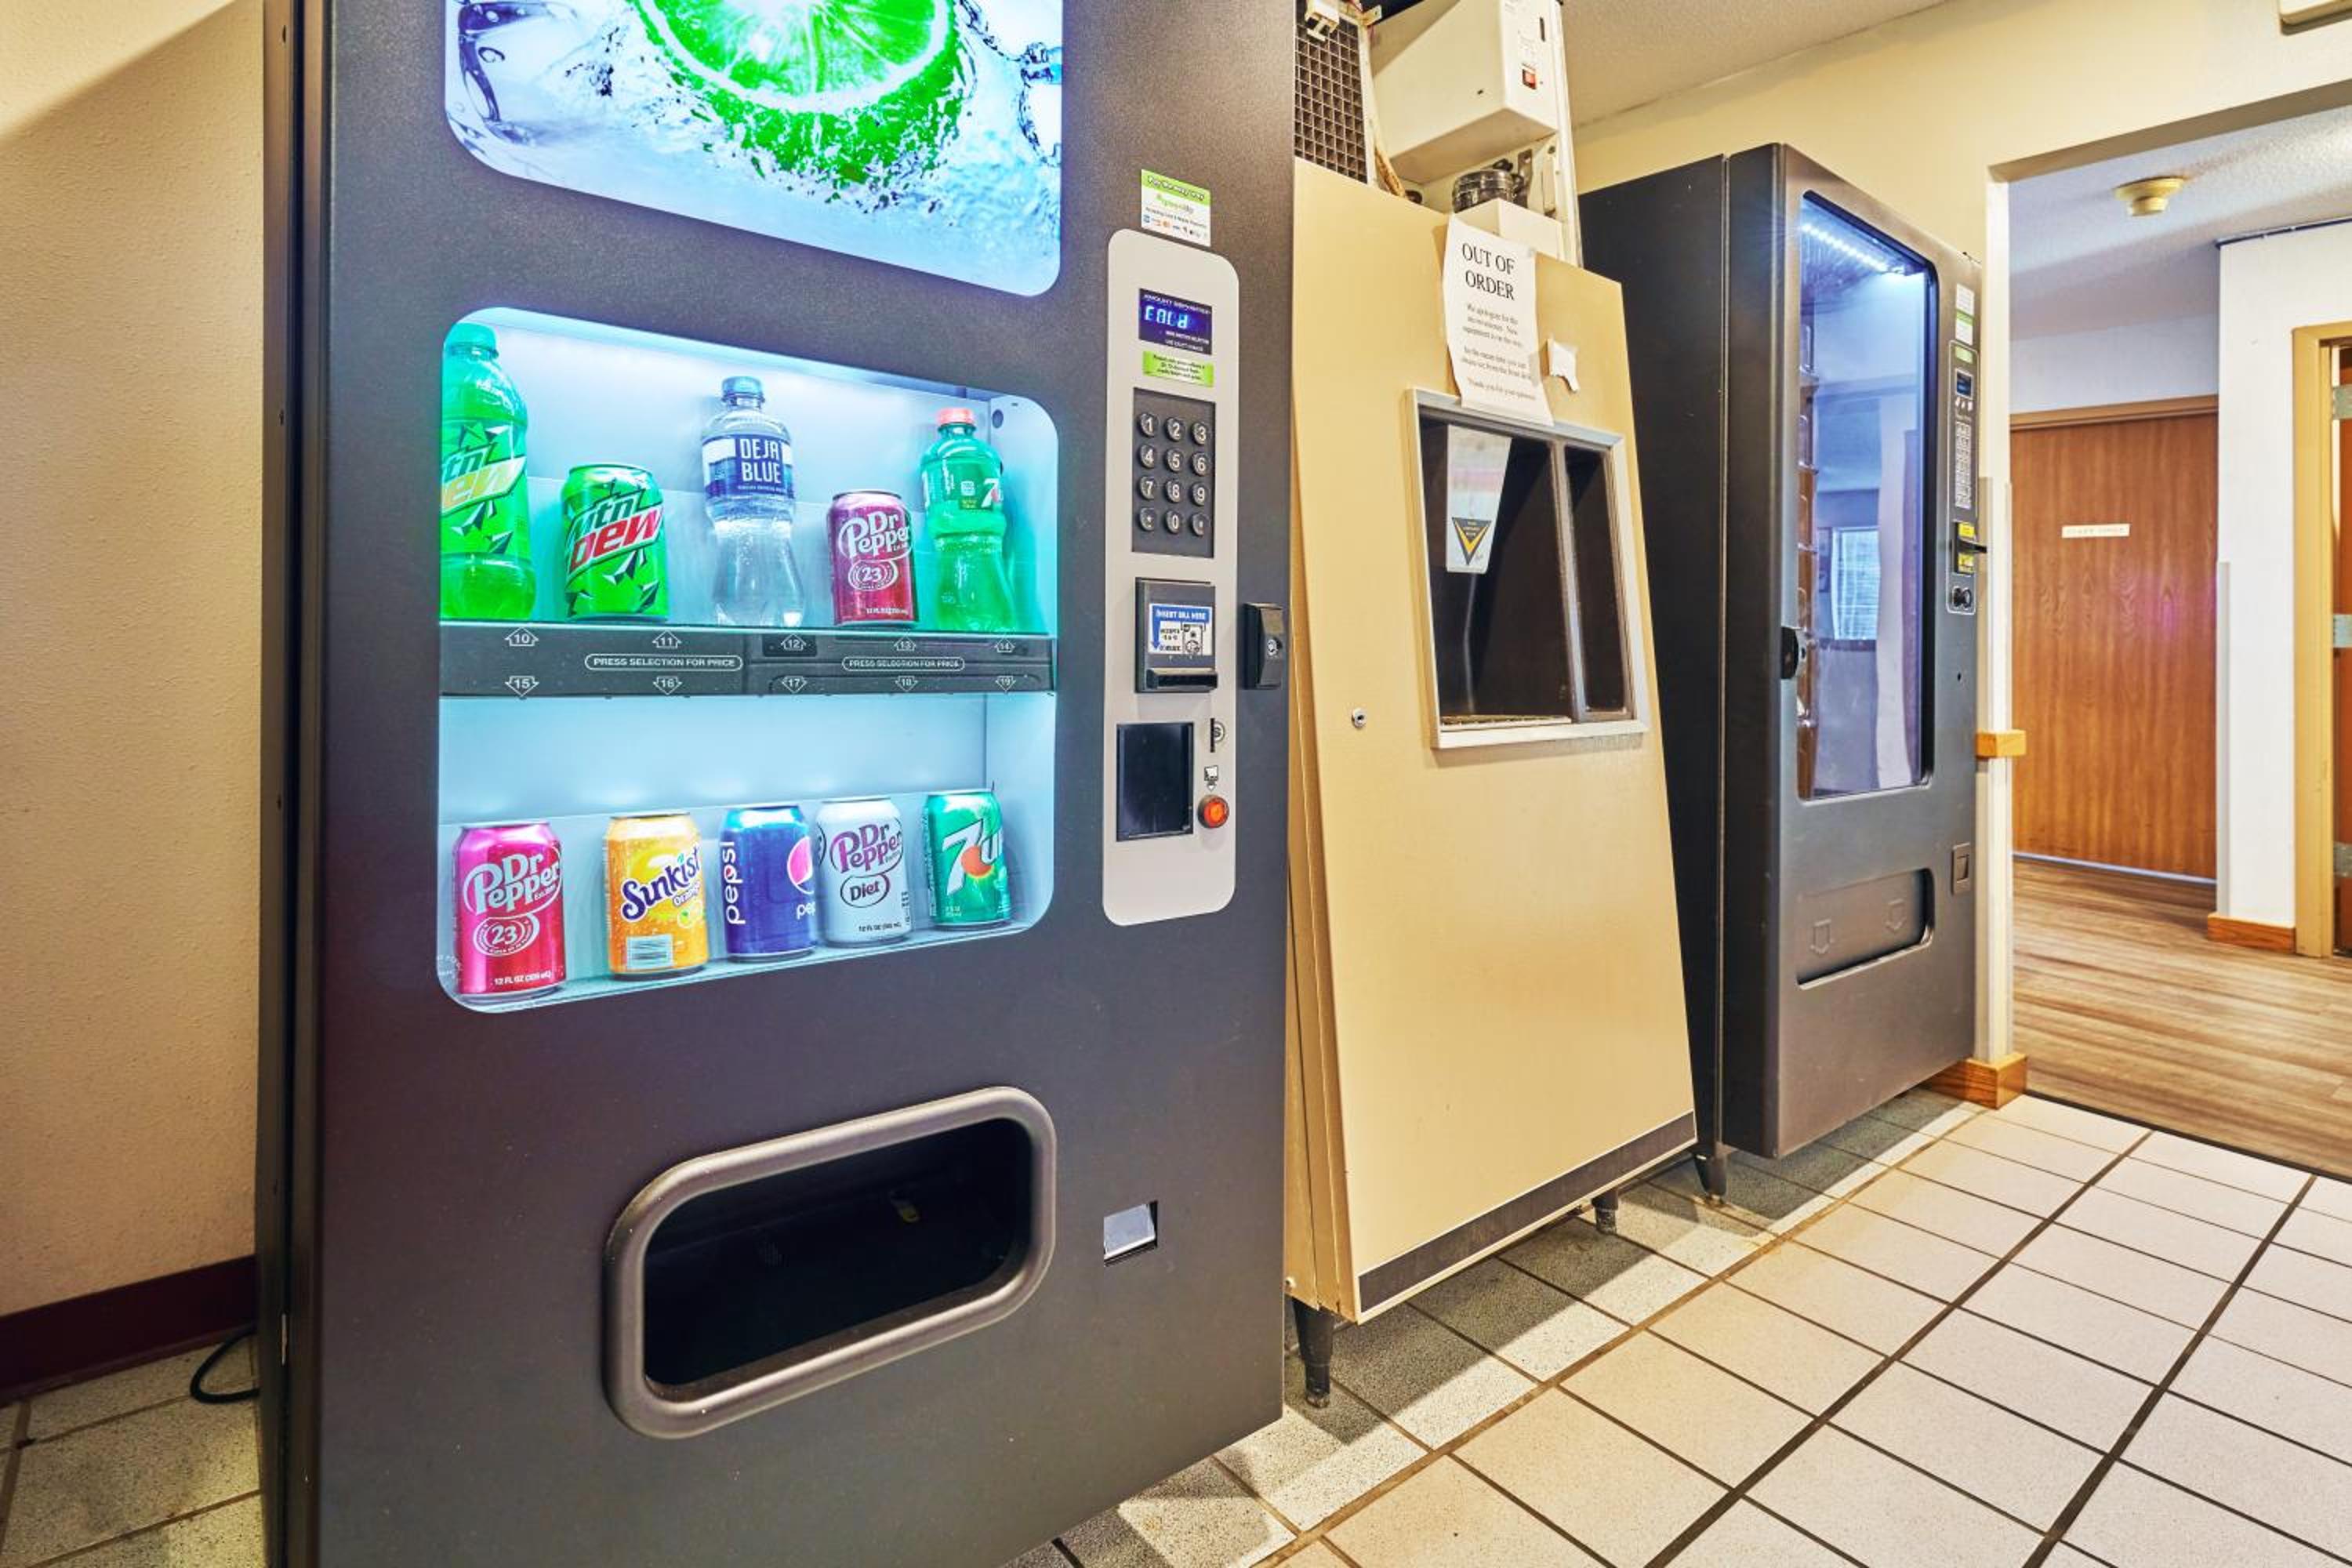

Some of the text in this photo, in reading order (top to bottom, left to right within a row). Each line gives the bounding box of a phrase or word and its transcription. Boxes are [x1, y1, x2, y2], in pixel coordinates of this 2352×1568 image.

[1461, 242, 1515, 275] OUT OF
[1465, 269, 1515, 301] ORDER
[739, 438, 779, 461] DEJA
[442, 450, 485, 484] tn
[741, 461, 782, 484] BLUE
[867, 510, 899, 535] Dr
[840, 517, 910, 559] Pepper
[862, 566, 883, 583] 23
[514, 634, 530, 644] 10
[659, 637, 673, 646] 11
[786, 639, 800, 649] 12
[898, 641, 912, 650] 13
[999, 643, 1011, 652] 14
[514, 678, 530, 689] 15
[661, 679, 675, 688] 16
[786, 677, 800, 688] 17
[900, 677, 913, 686] 18
[1000, 677, 1011, 686] 19
[858, 823, 890, 848] Dr
[830, 830, 902, 874] Pepper
[942, 818, 1004, 896] 7U
[502, 853, 544, 884] Dr
[466, 861, 559, 916] Pepper
[622, 845, 700, 920] Sunkist
[719, 841, 746, 924] pepsi
[849, 880, 880, 902] Diet
[491, 924, 517, 945] 23
